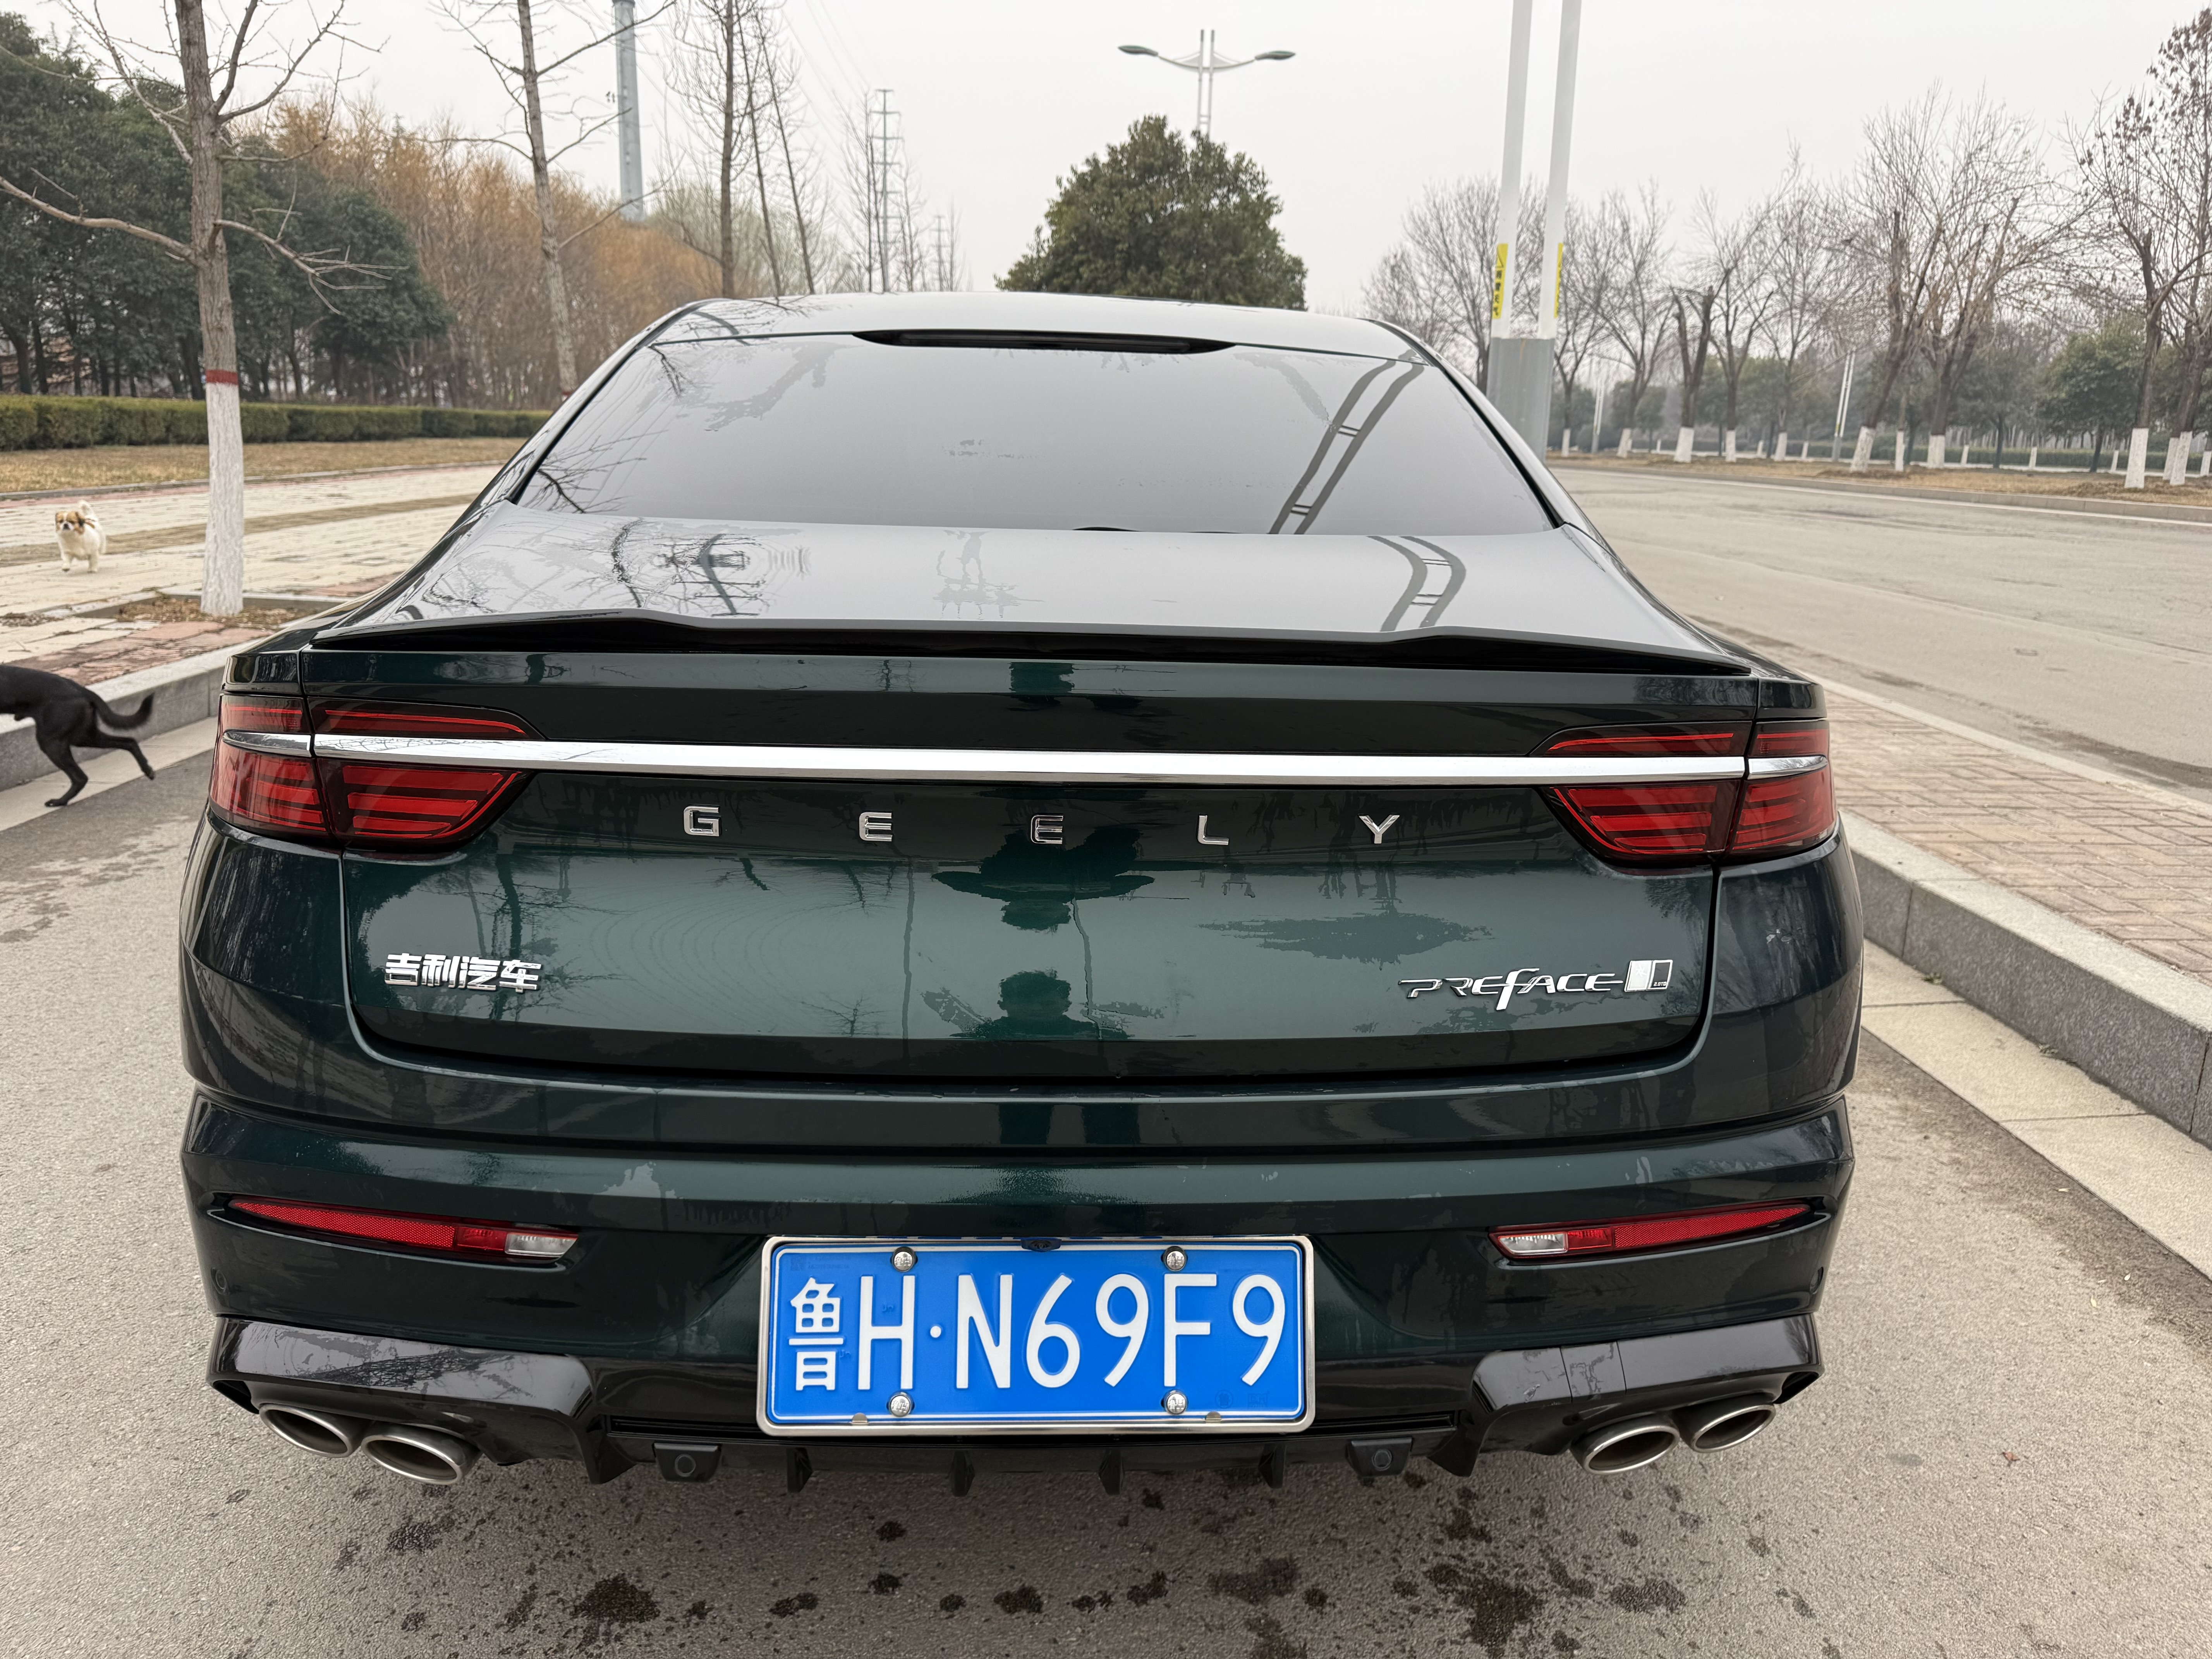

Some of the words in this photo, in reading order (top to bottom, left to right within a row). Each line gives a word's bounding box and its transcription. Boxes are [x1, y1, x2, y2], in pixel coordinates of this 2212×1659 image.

[684, 806, 1400, 846] GEELY
[385, 952, 542, 993] 吉利汽车
[789, 1274, 1285, 1391] 鲁H·N69F9
